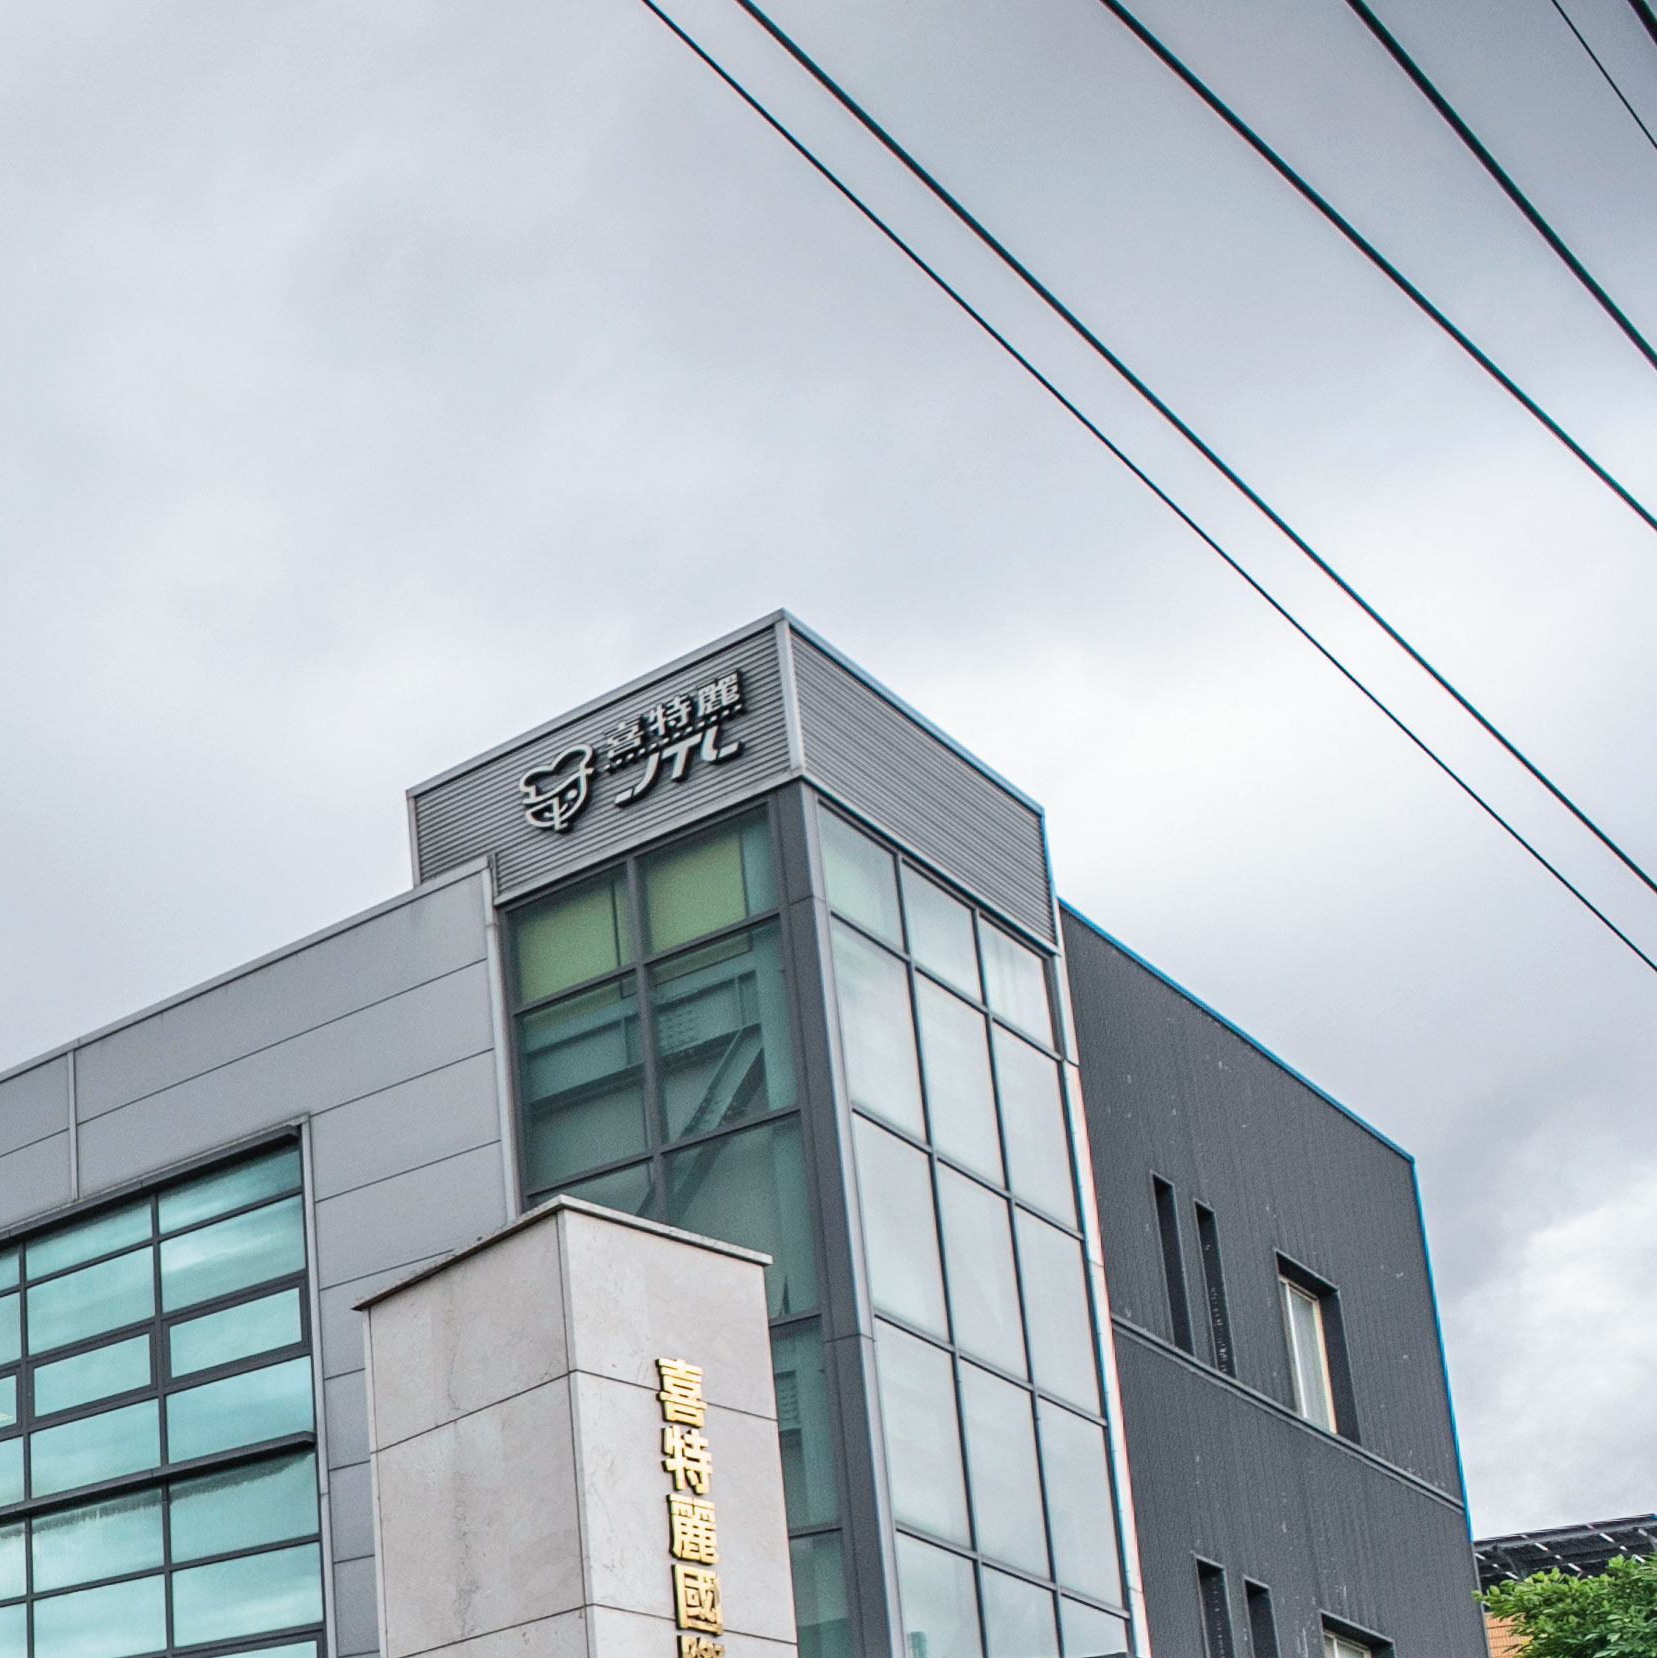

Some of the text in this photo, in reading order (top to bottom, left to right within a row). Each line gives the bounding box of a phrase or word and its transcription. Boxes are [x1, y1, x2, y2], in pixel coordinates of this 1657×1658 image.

[604, 669, 743, 759] 喜特麗
[615, 726, 742, 806] JTL
